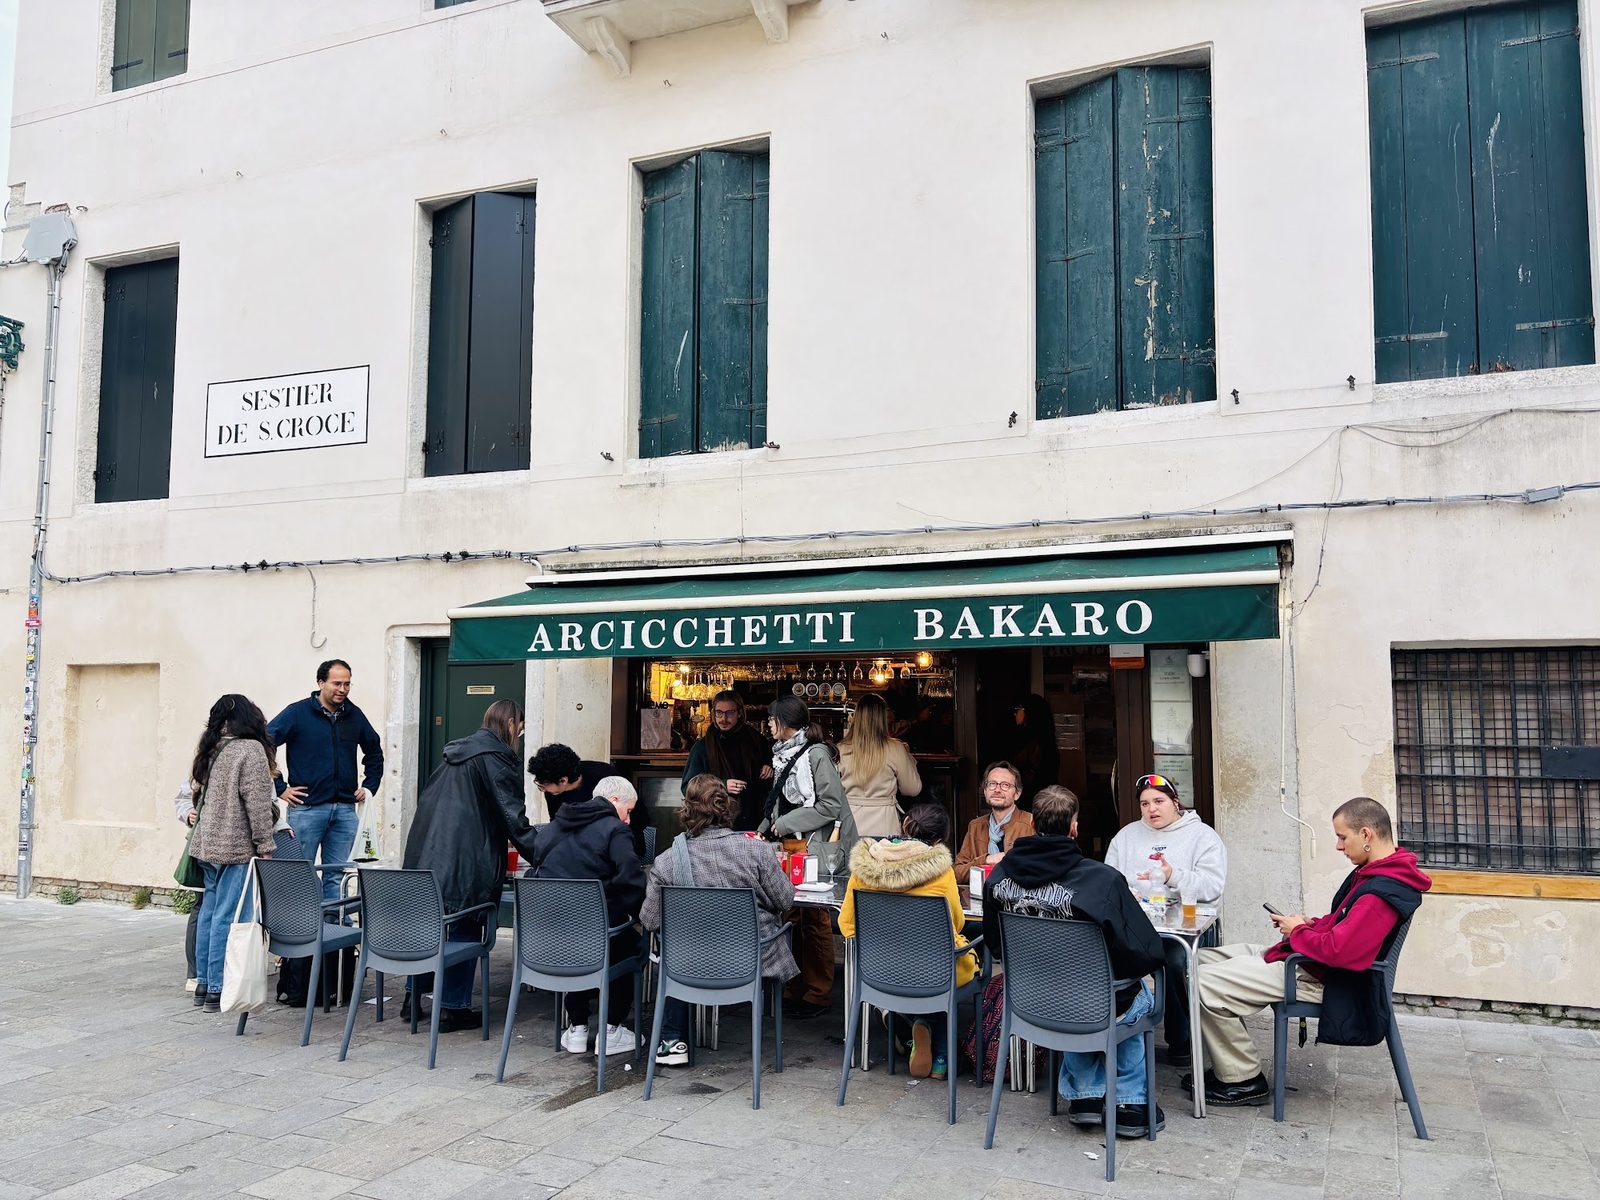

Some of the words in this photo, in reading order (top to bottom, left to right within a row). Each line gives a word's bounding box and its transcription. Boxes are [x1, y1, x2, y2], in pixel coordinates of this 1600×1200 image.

[241, 382, 333, 412] SESTIER
[217, 423, 248, 445] DE
[527, 611, 856, 652] ARCICCHETTI
[913, 600, 1153, 641] BAKARO
